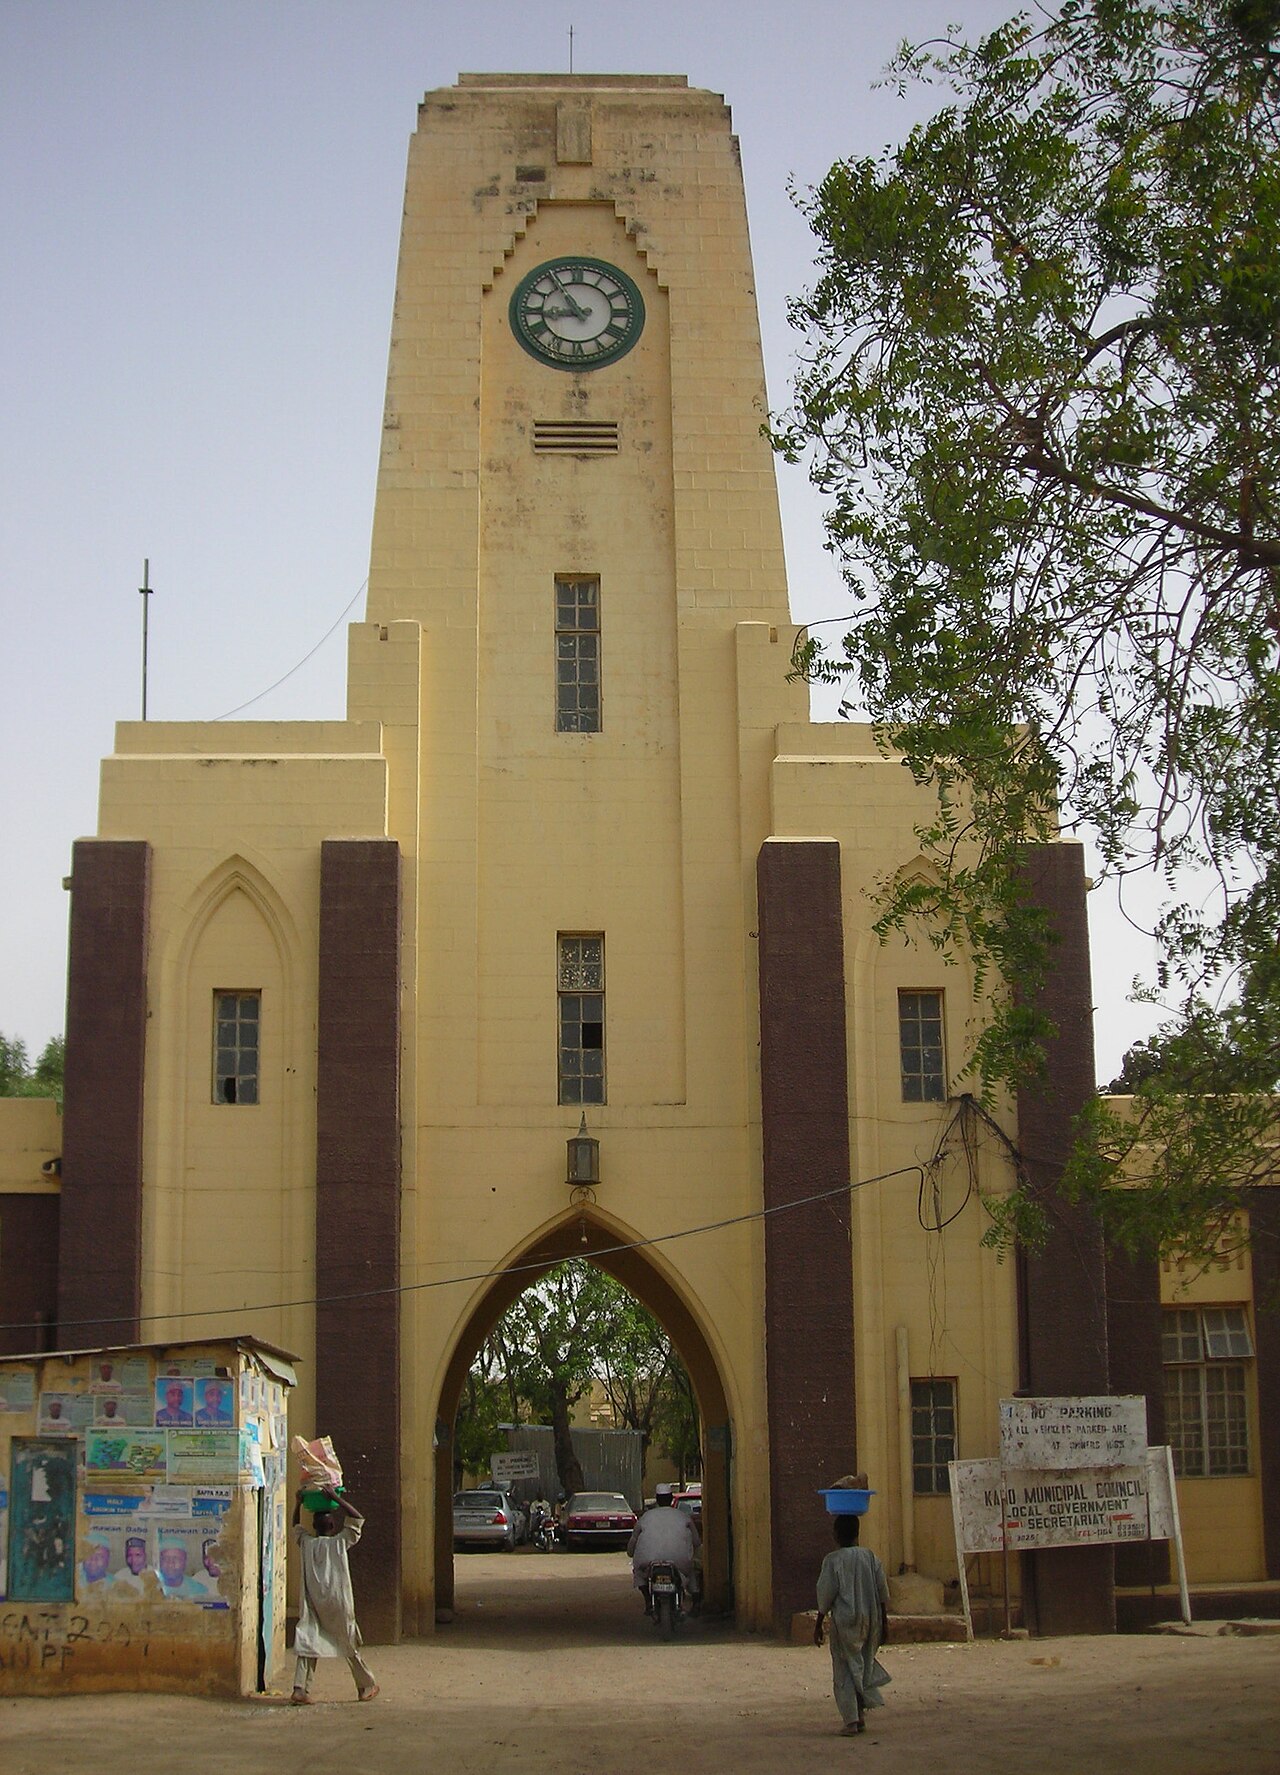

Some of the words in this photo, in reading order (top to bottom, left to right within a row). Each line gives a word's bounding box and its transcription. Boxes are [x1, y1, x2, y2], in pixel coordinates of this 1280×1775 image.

[1031, 1406, 1046, 1419] NO
[1060, 1406, 1113, 1419] PARKING
[1024, 1484, 1088, 1505] MUNICIPAL
[1096, 1480, 1145, 1499] COUNCIL
[1006, 1504, 1044, 1518] OCAL
[1049, 1498, 1130, 1516] GOVERNMENT
[1027, 1513, 1105, 1531] SECRETARIAT
